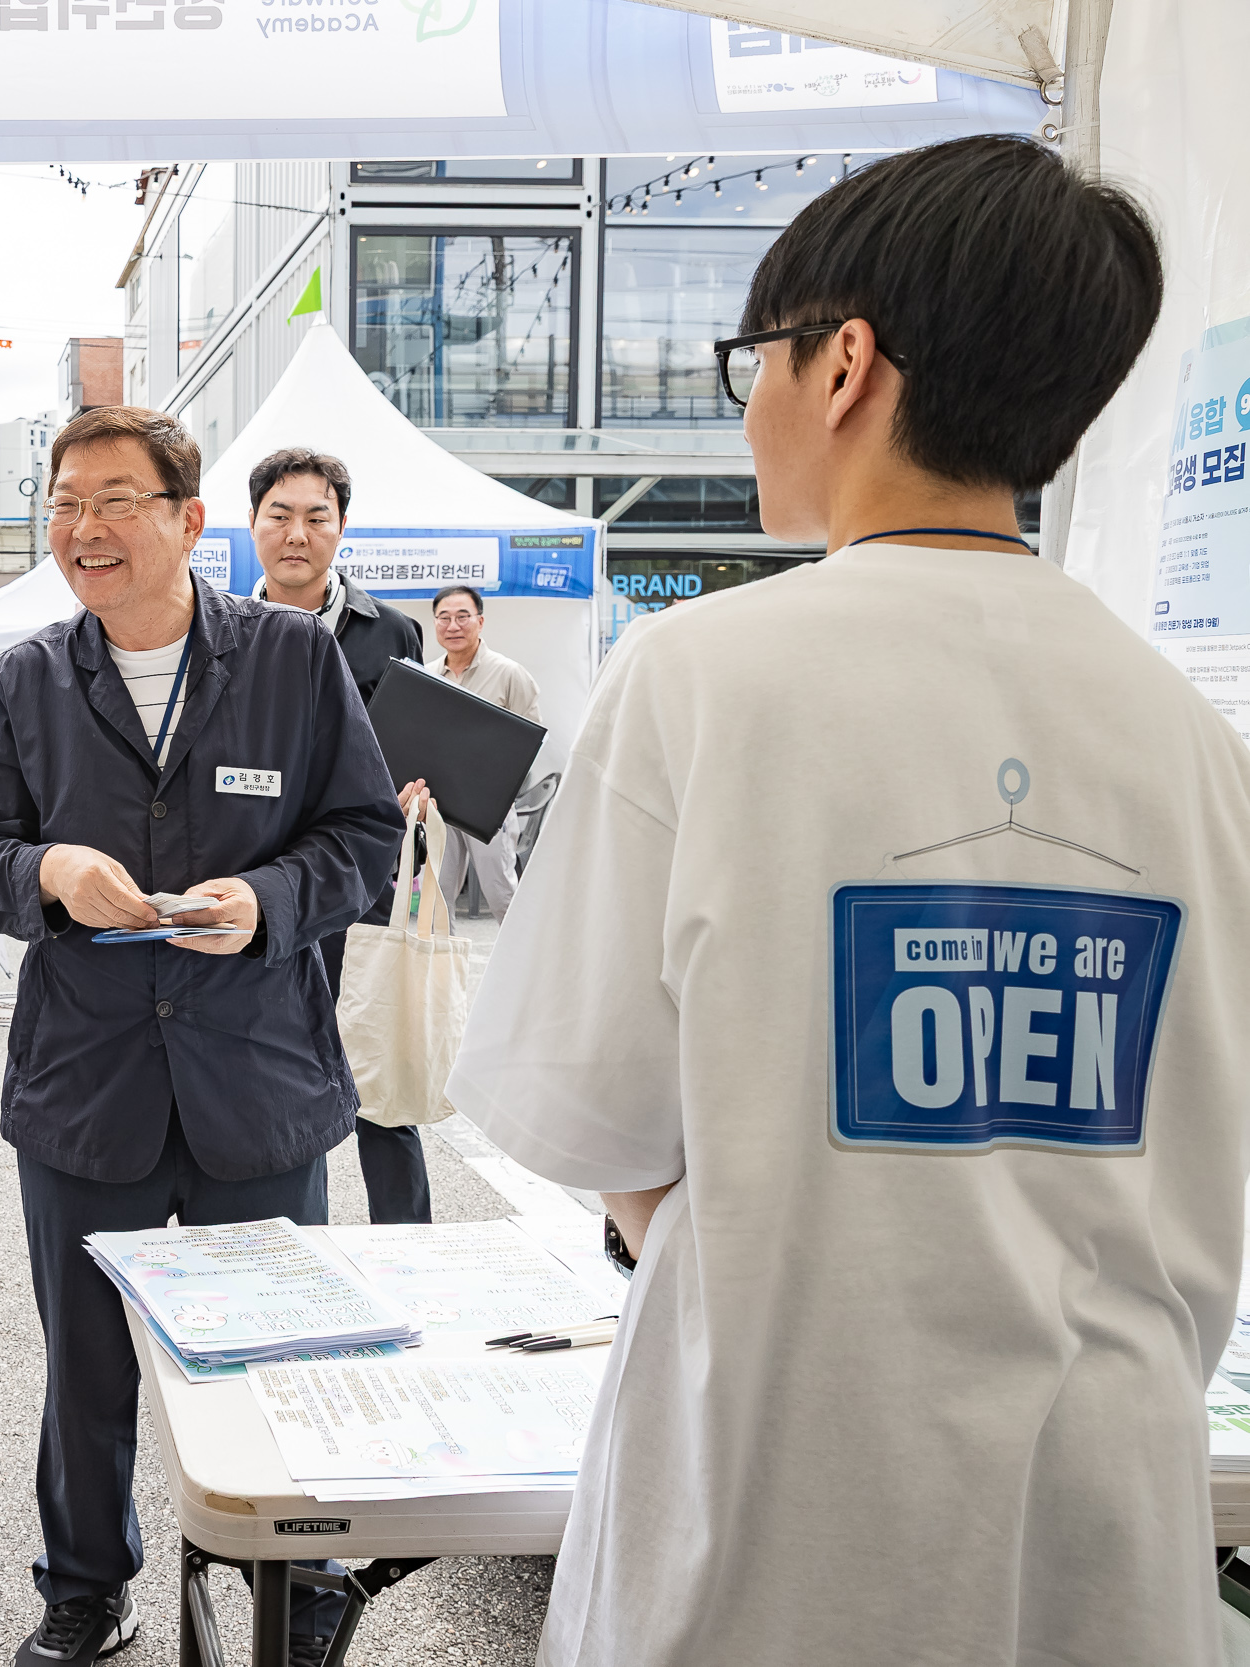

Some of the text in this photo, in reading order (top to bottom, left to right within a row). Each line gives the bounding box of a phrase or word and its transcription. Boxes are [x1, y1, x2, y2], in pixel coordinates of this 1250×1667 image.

[1189, 395, 1227, 441] 융합
[1201, 442, 1246, 487] 모집
[191, 550, 228, 563] 진구네
[612, 574, 703, 597] BRAND
[905, 930, 1126, 981] come in we are
[890, 985, 1119, 1111] OPEN
[329, 1311, 377, 1326] 나와
[284, 1522, 341, 1532] LIFETIME
